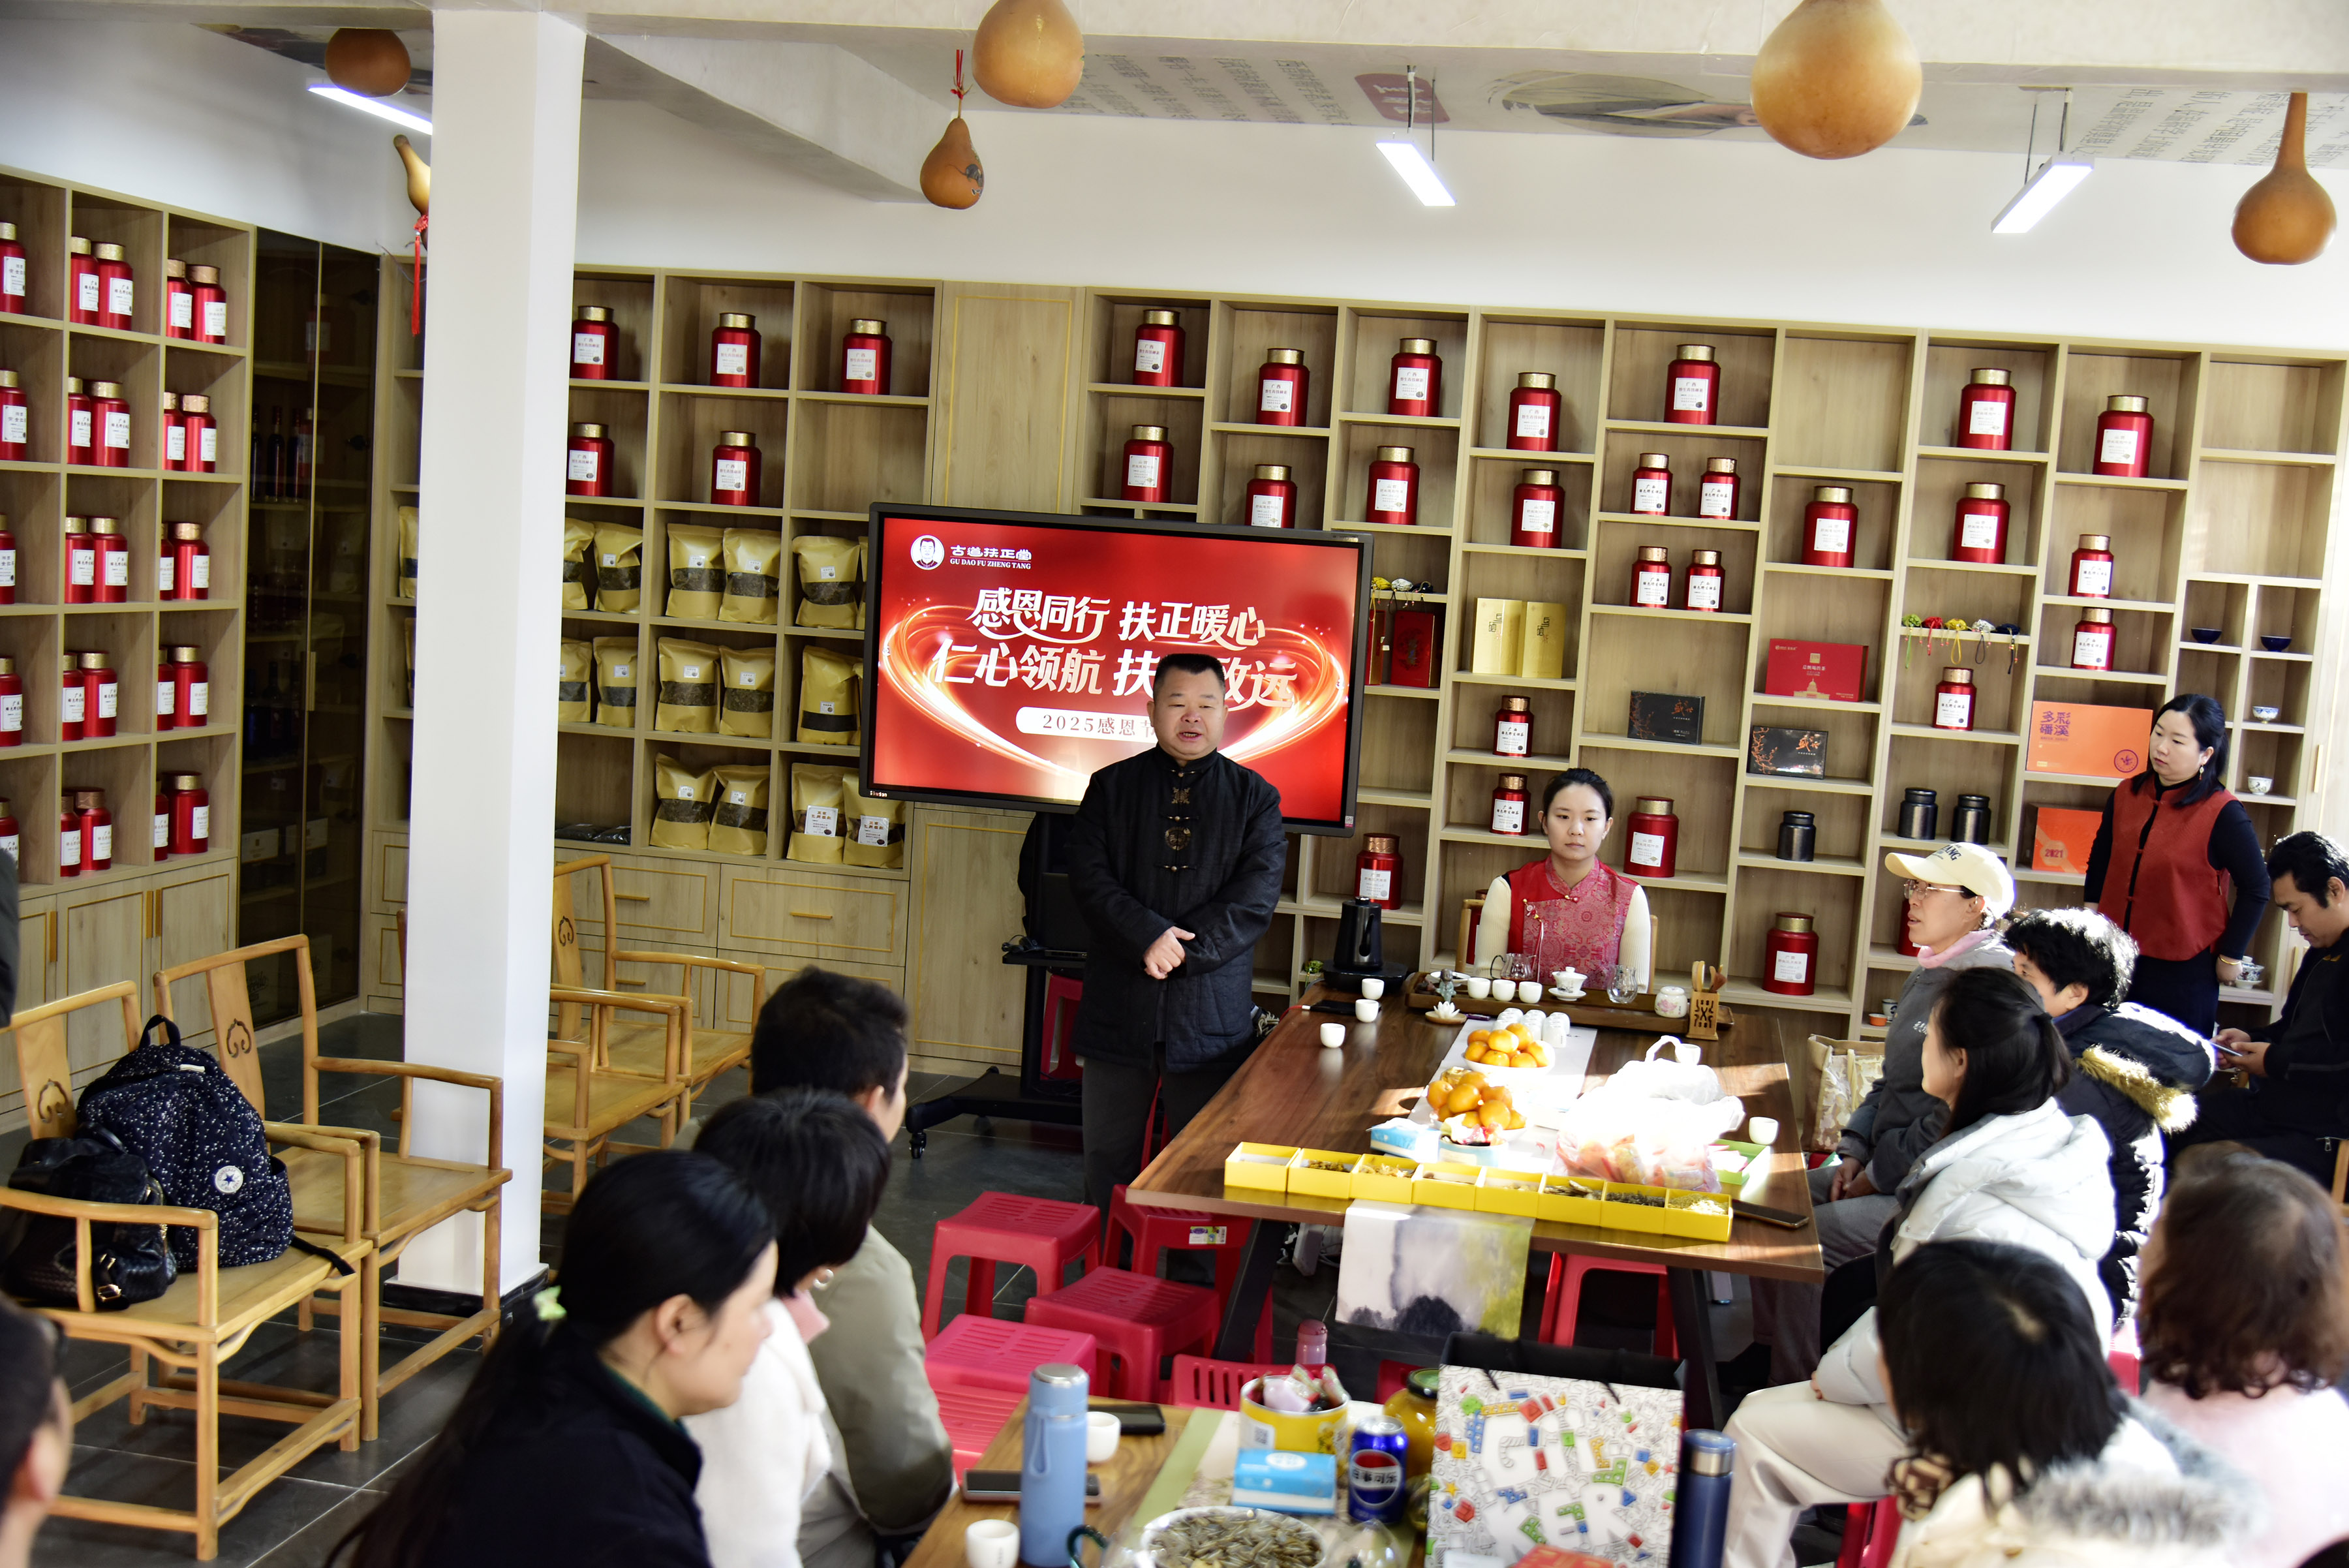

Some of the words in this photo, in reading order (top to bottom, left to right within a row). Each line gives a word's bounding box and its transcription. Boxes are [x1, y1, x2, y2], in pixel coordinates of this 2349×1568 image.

[950, 544, 1032, 561] 古道扶正堂
[966, 587, 1111, 644] 感恩同行
[1118, 600, 1265, 651] 扶正暖心
[932, 638, 1106, 695] 仁心领航
[1113, 649, 1298, 712] 扶致远
[2040, 711, 2072, 725] 多彩
[2039, 724, 2069, 737] 磻溪
[2044, 848, 2063, 858] 2021
